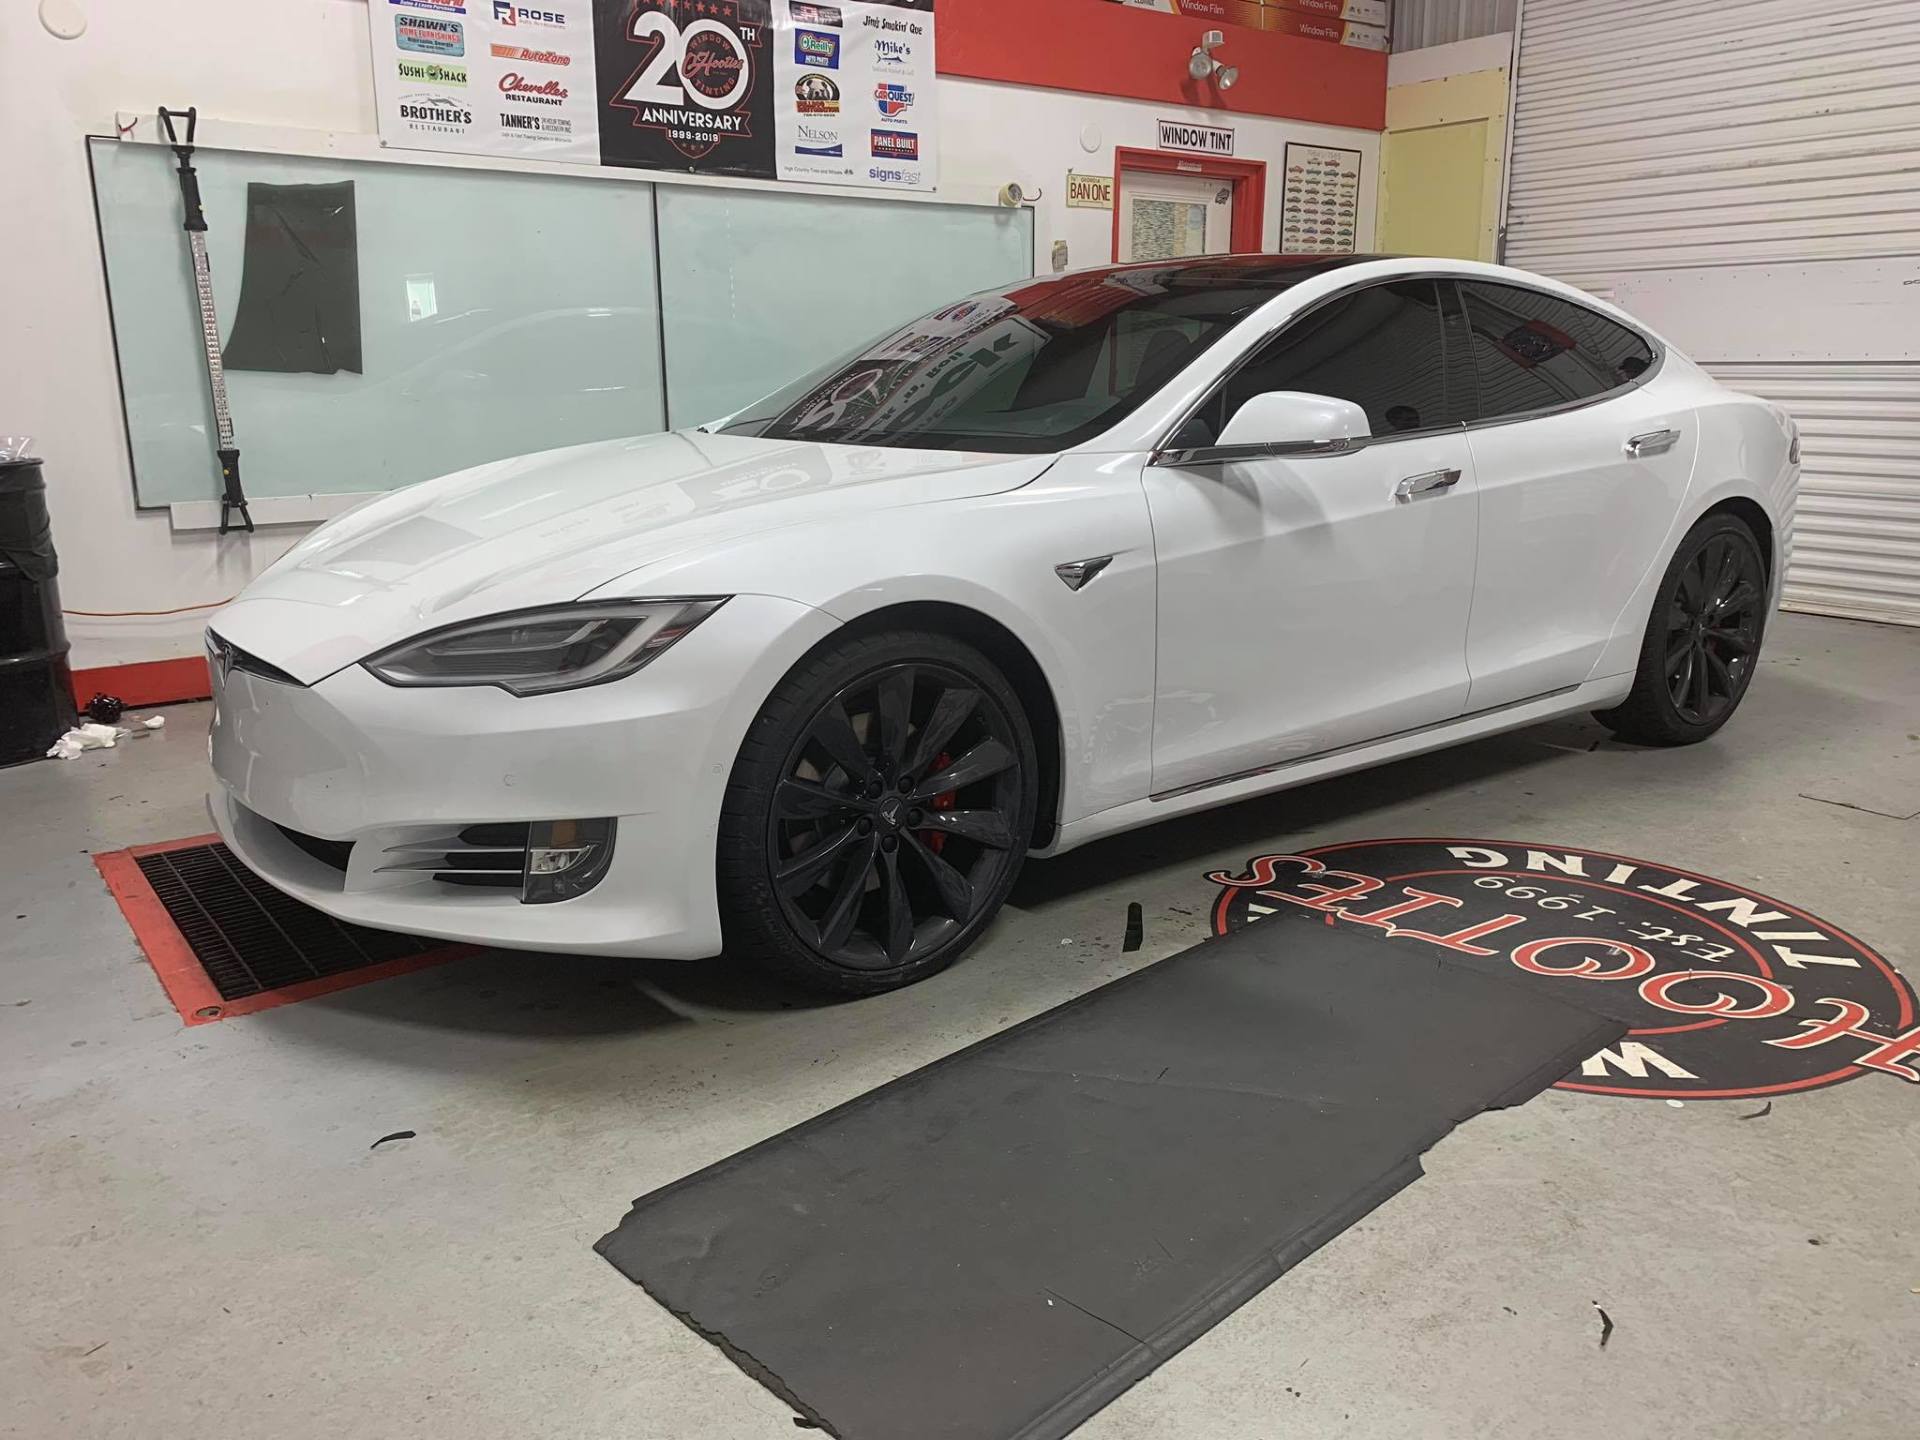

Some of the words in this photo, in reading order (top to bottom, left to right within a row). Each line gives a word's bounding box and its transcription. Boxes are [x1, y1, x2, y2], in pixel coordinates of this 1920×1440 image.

[1180, 0, 1209, 12] Window
[1210, 4, 1224, 14] Film
[1325, 1, 1339, 11] Film
[518, 7, 566, 24] ROSE
[399, 27, 417, 38] HOME
[400, 17, 458, 33] SHAWN'S
[863, 15, 880, 29] Jim's
[881, 18, 909, 33] Smokin'
[909, 23, 923, 35] Que
[1299, 24, 1325, 36] Window
[1326, 28, 1339, 38] Film
[801, 35, 834, 55] O'Reilly
[874, 40, 911, 55] Mike's
[520, 48, 571, 66] AutoZone
[623, 10, 750, 110] 20
[740, 27, 755, 41] TH
[398, 63, 425, 78] SUSHI
[439, 68, 467, 83] SHACK
[498, 72, 569, 98] Chevelles
[505, 93, 563, 106] RESTAURANT
[875, 89, 914, 103] CARQUEST
[400, 104, 472, 124] BROTHER'S
[500, 113, 540, 130] TANNER'S
[641, 107, 742, 131] ANNIVERSARY
[409, 123, 465, 134] RESTAURANT
[874, 136, 895, 149] PANEL
[896, 138, 915, 150] BUILT
[1161, 125, 1208, 147] WINDOW
[1210, 132, 1232, 151] TINT
[1070, 182, 1090, 200] BAN
[1092, 184, 1111, 201] ONE
[1473, 875, 1616, 921] 1999
[1446, 847, 1862, 970] TINTING
[1628, 921, 1735, 962] Est.
